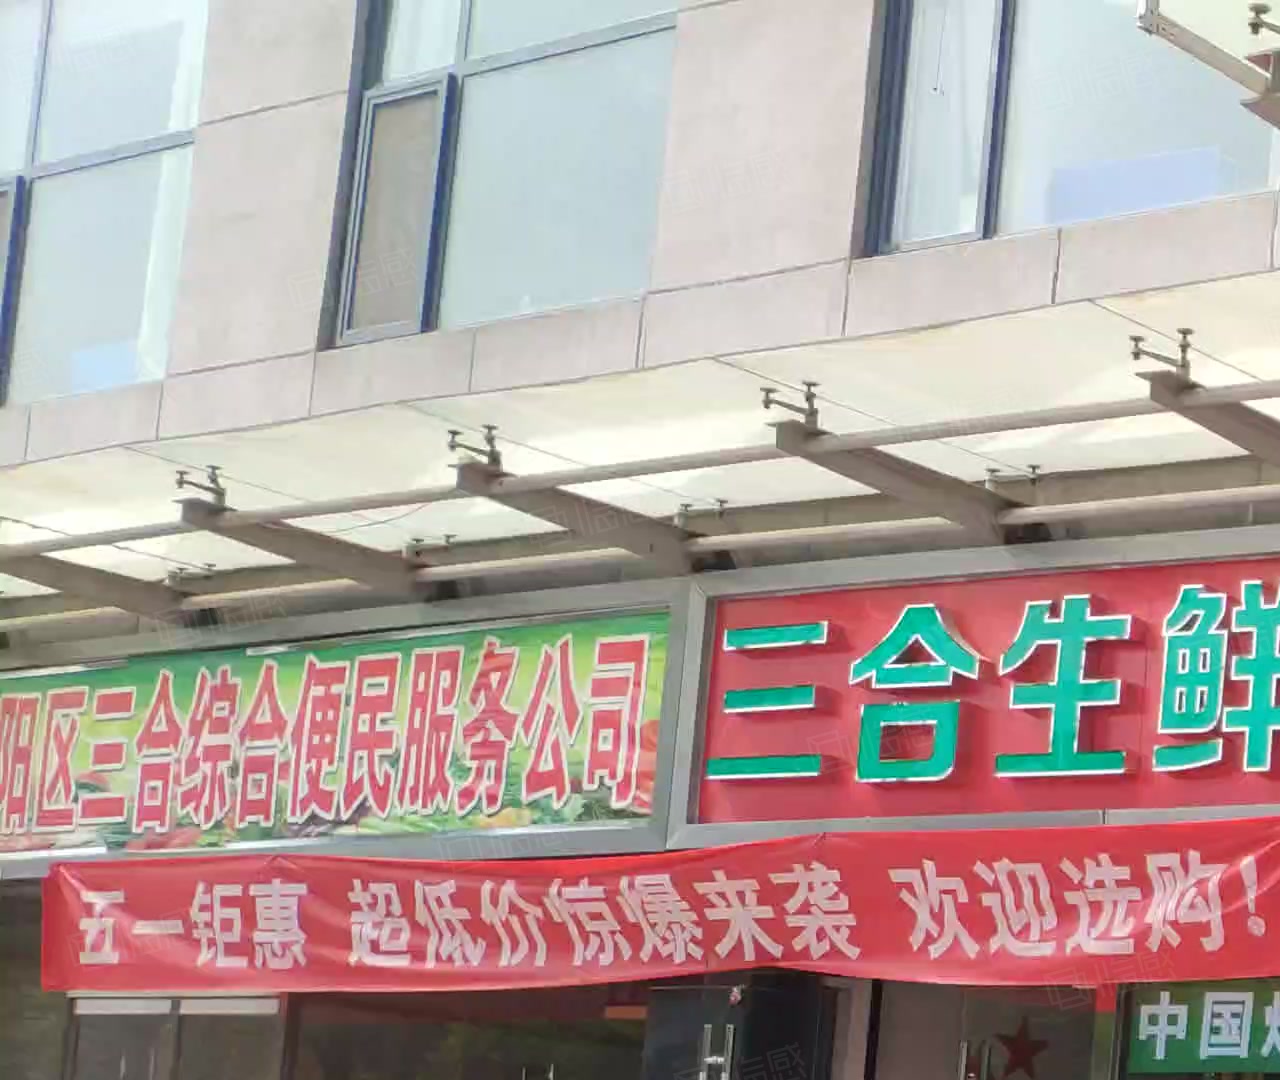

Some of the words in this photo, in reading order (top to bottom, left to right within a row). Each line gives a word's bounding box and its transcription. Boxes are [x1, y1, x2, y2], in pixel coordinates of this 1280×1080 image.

[78, 879, 309, 969] 五一钜惠
[347, 858, 861, 968] 超低价惊爆来袭
